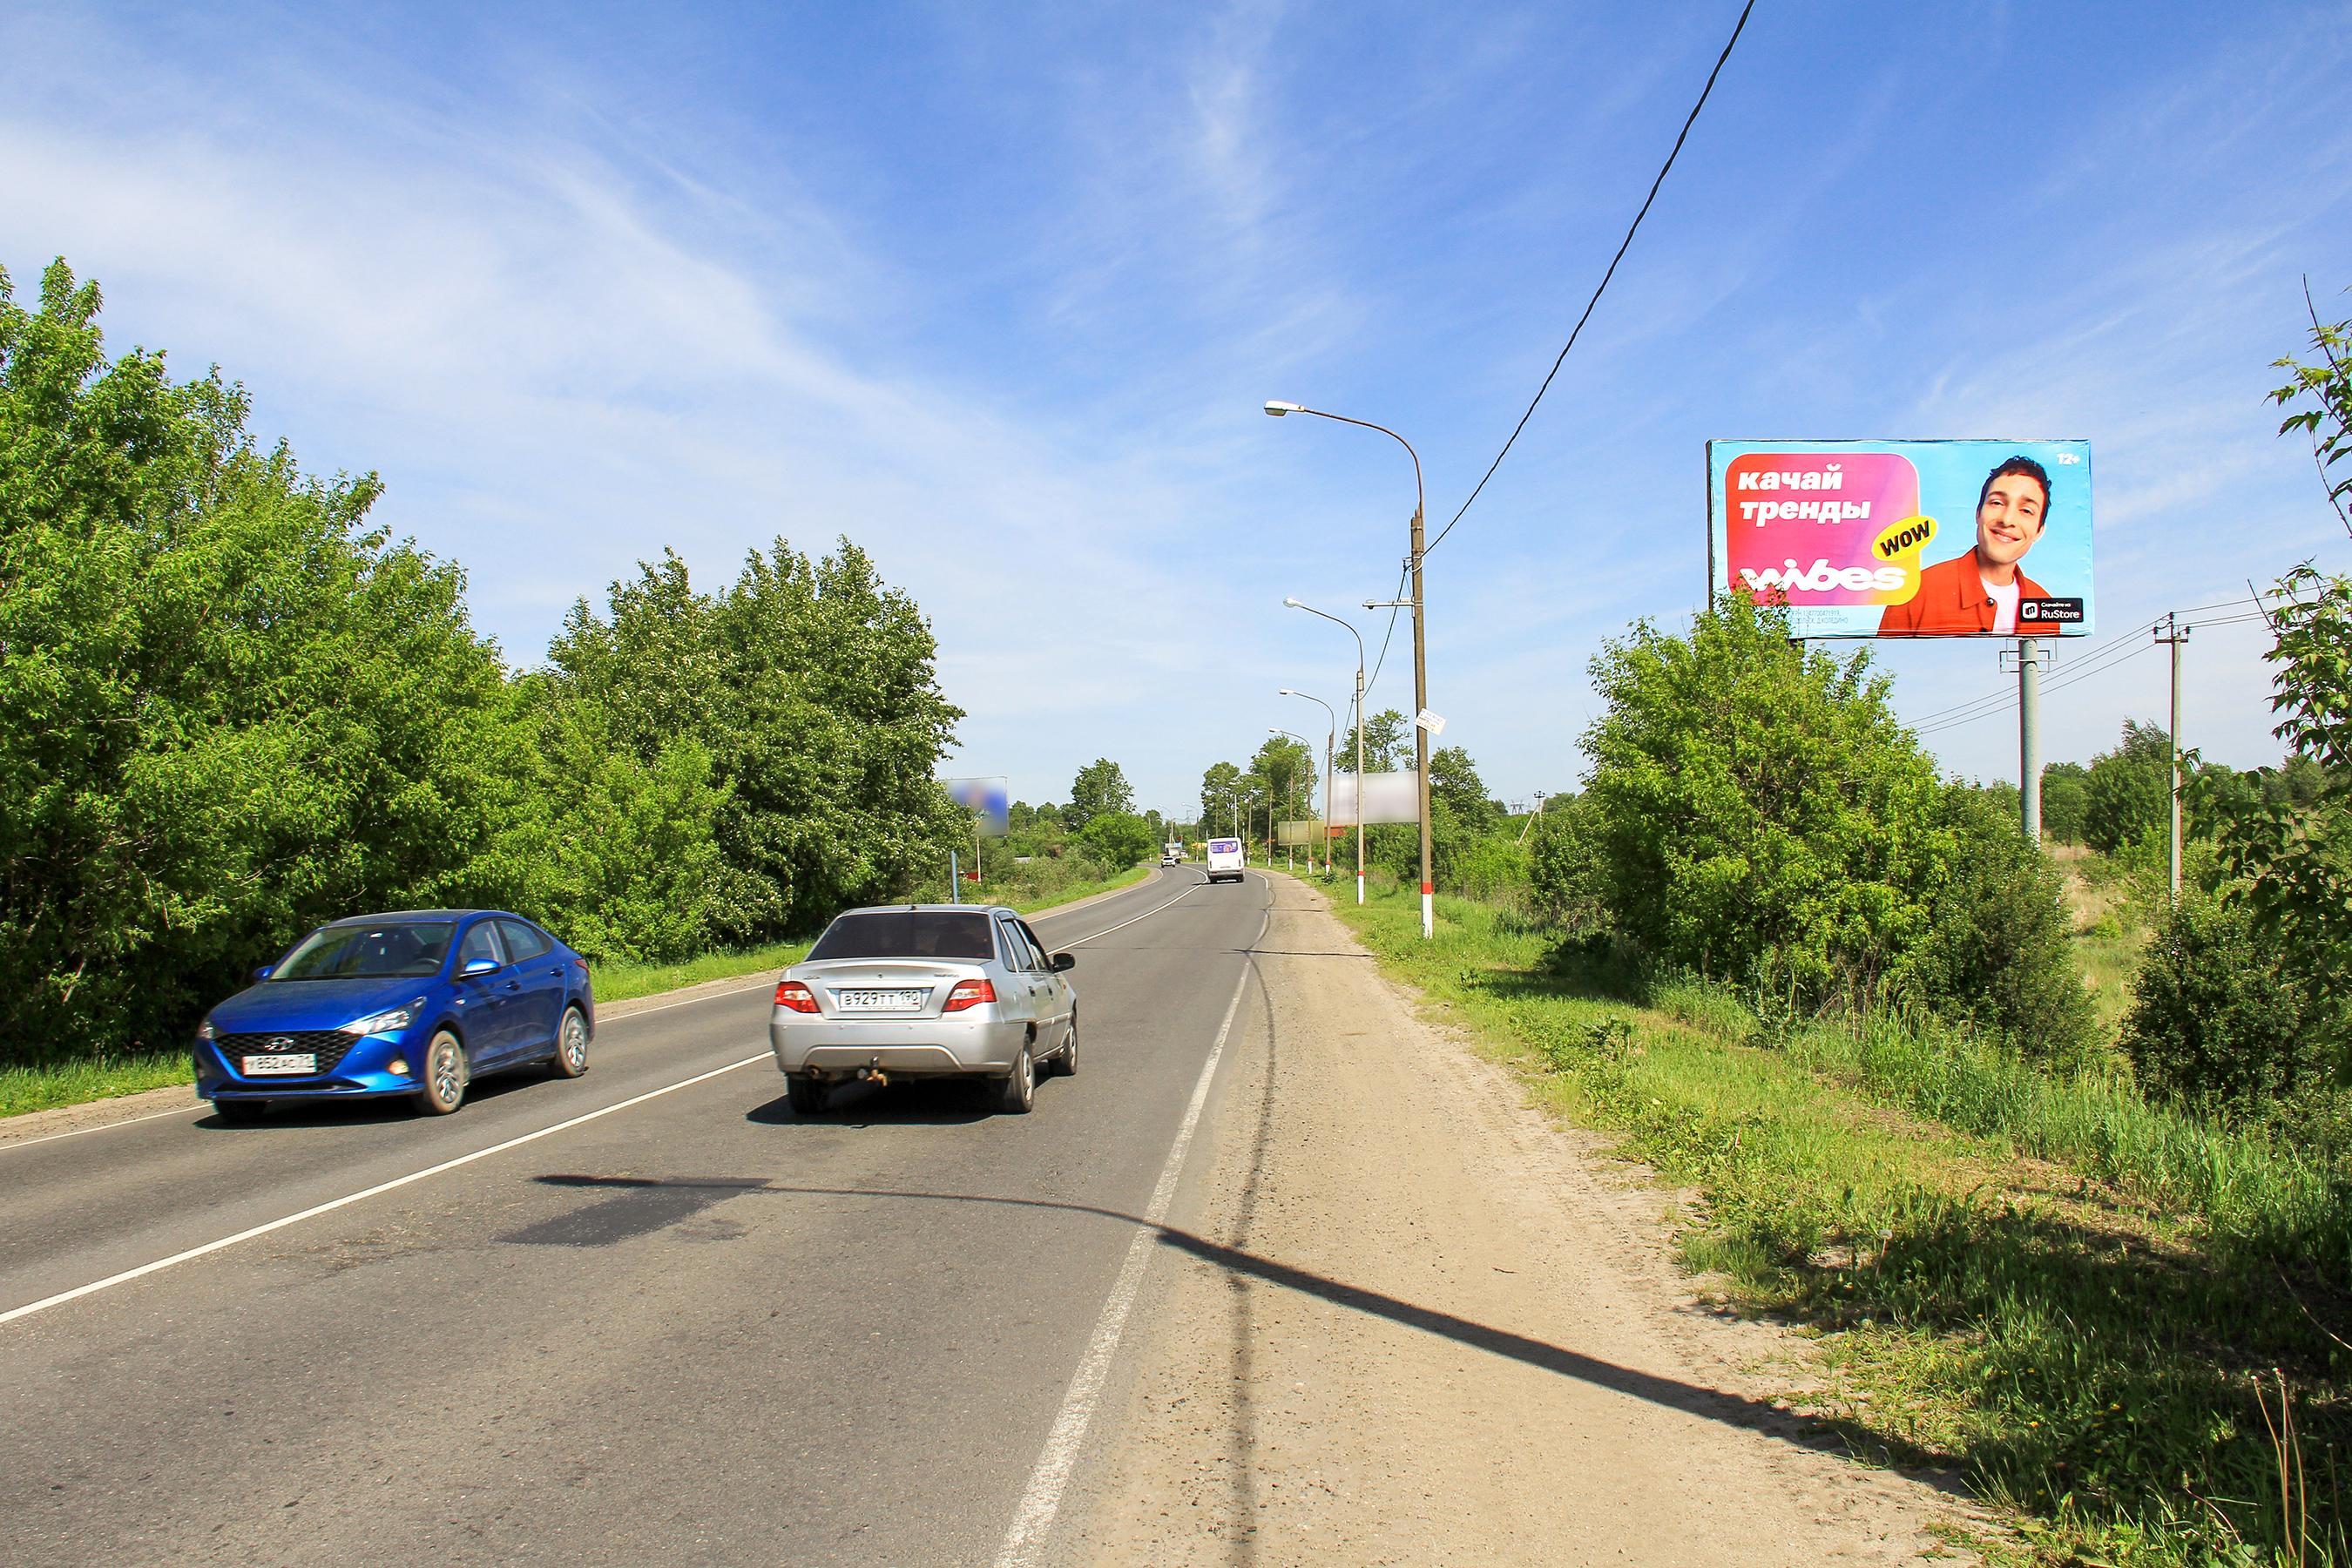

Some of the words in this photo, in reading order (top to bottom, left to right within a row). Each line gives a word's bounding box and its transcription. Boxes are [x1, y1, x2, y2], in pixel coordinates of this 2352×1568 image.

[2056, 453, 2080, 465] 12+
[1738, 463, 1843, 490] качай
[1740, 501, 1872, 528] тренды
[1739, 558, 1908, 592] wibes
[2041, 610, 2079, 618] RuStore
